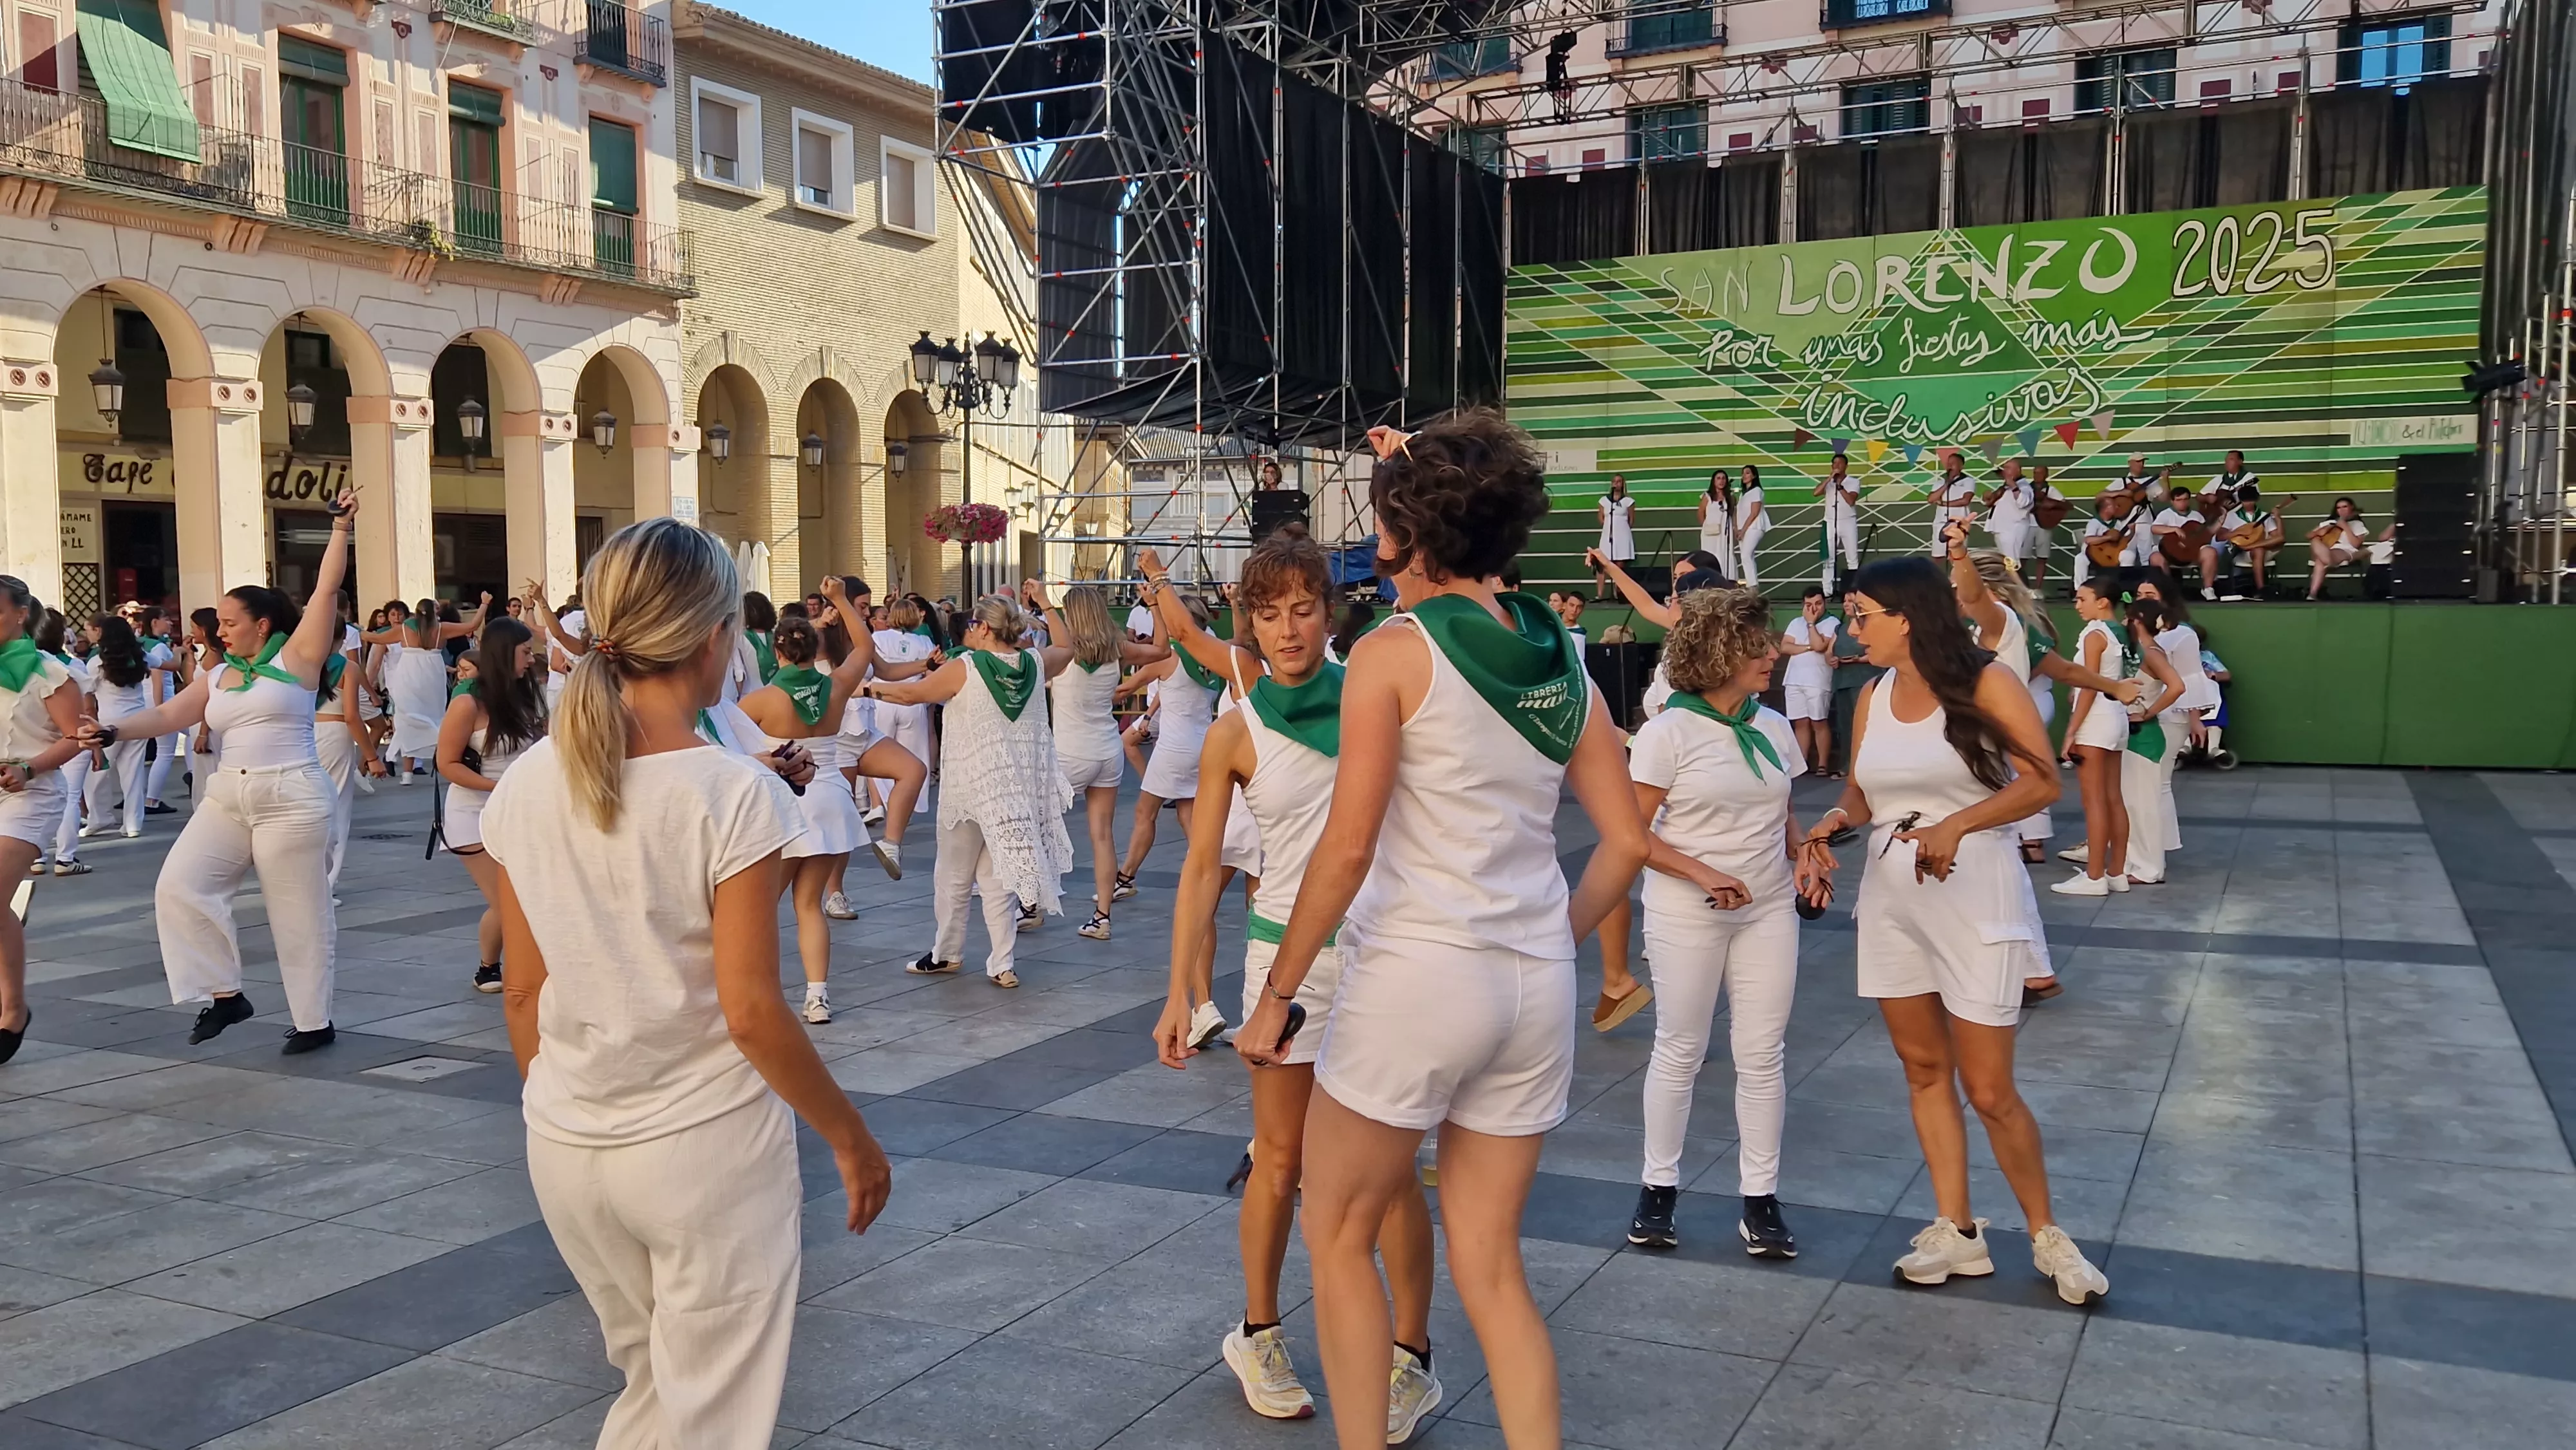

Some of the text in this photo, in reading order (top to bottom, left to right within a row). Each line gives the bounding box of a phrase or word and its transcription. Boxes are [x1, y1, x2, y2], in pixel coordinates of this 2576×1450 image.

[1660, 209, 2334, 316] SAN LORENZO 2025
[1699, 308, 2155, 374] Por unas fiestas más
[1799, 366, 2102, 442] inclusivas
